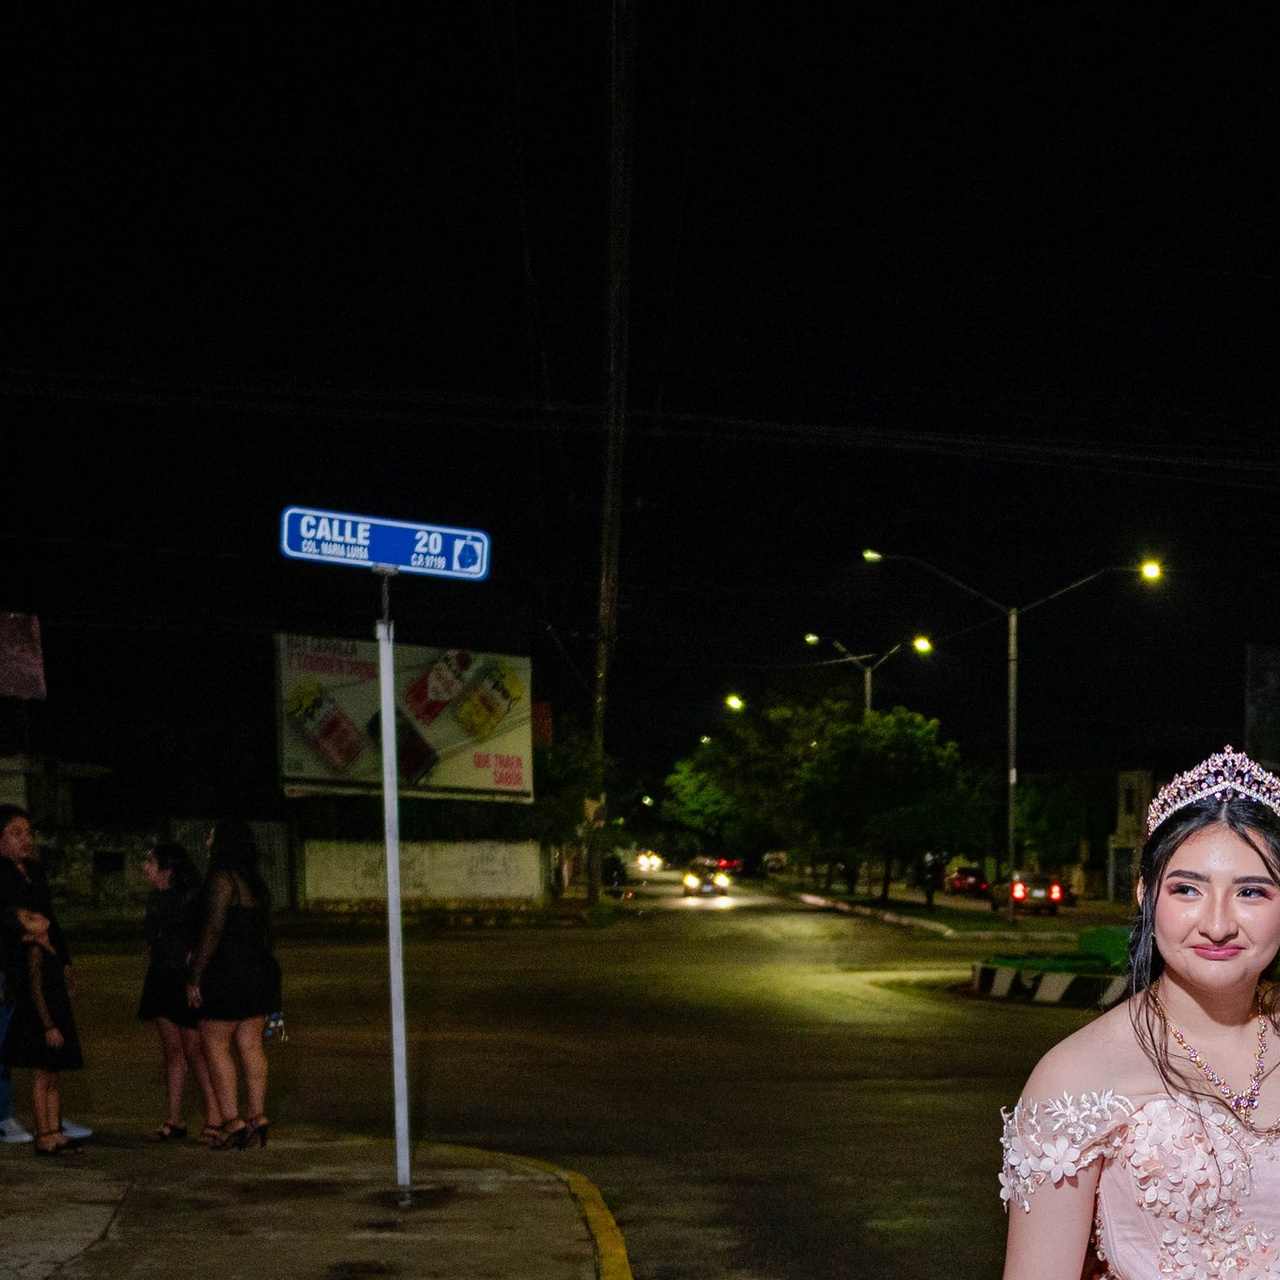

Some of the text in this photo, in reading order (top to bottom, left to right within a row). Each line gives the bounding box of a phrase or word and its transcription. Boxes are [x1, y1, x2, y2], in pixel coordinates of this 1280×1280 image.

[300, 515, 443, 555] CALLE 20
[301, 539, 369, 560] COL. MARIA LUISA
